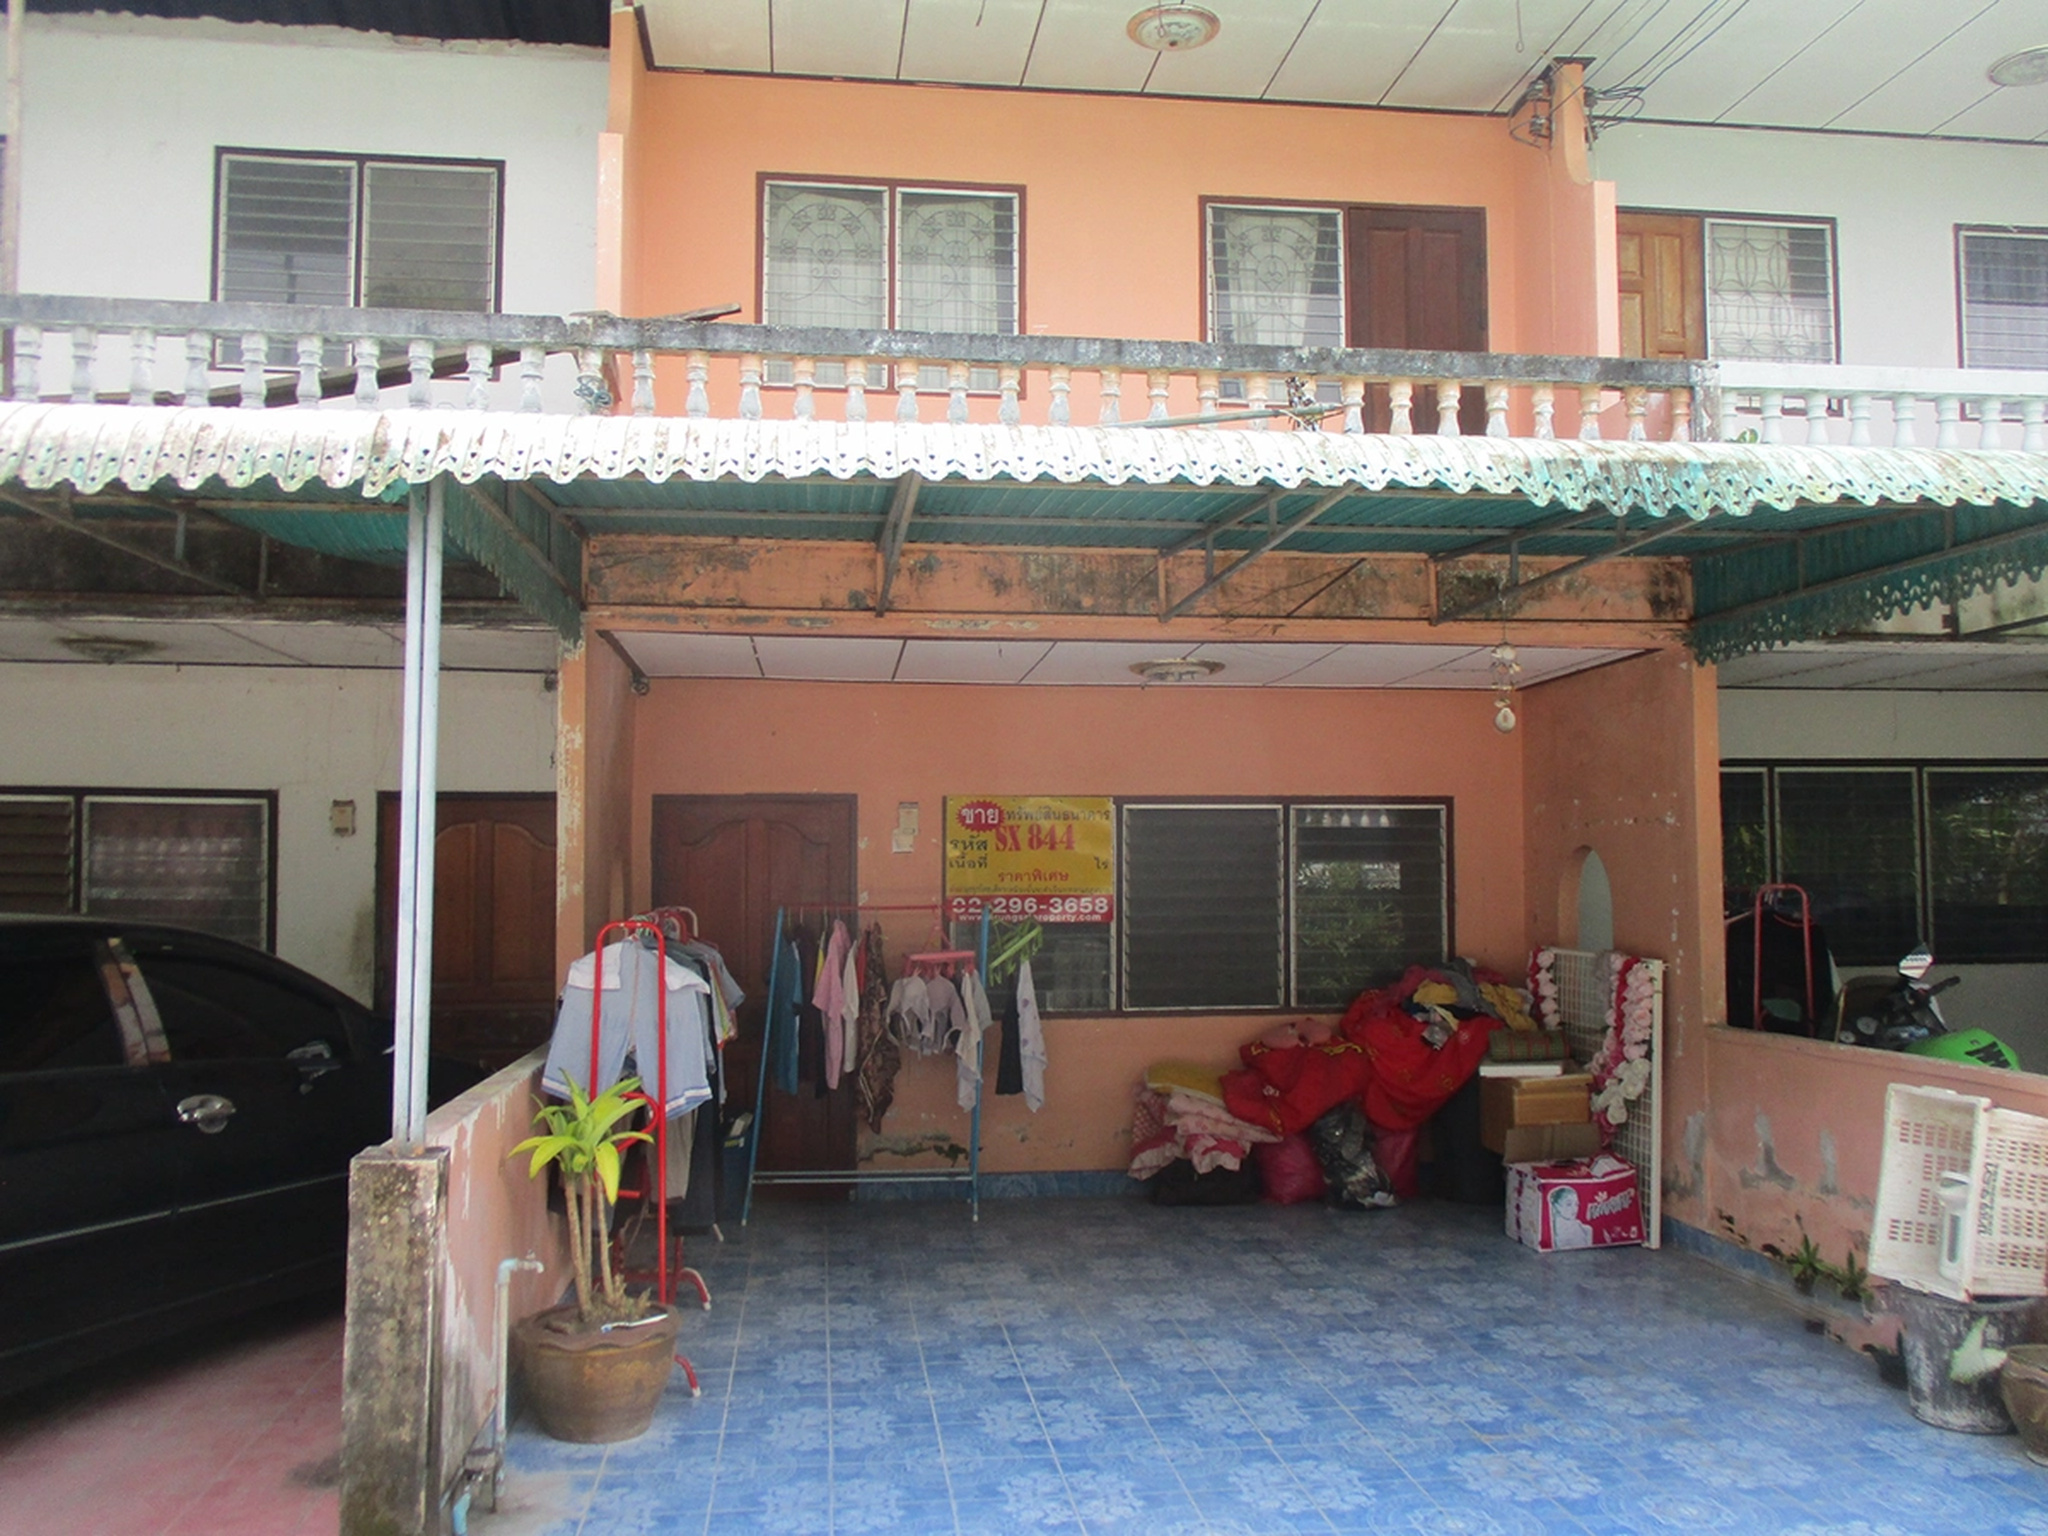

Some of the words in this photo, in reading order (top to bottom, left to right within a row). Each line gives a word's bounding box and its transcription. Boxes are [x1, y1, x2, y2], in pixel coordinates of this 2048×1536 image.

[962, 807, 999, 825] ขาย
[950, 834, 988, 851] รหัส
[995, 824, 1021, 851] SX
[1028, 823, 1075, 851] 844
[998, 869, 1068, 883] ราคาพิเศษ
[952, 897, 1108, 914] 02296-3658
